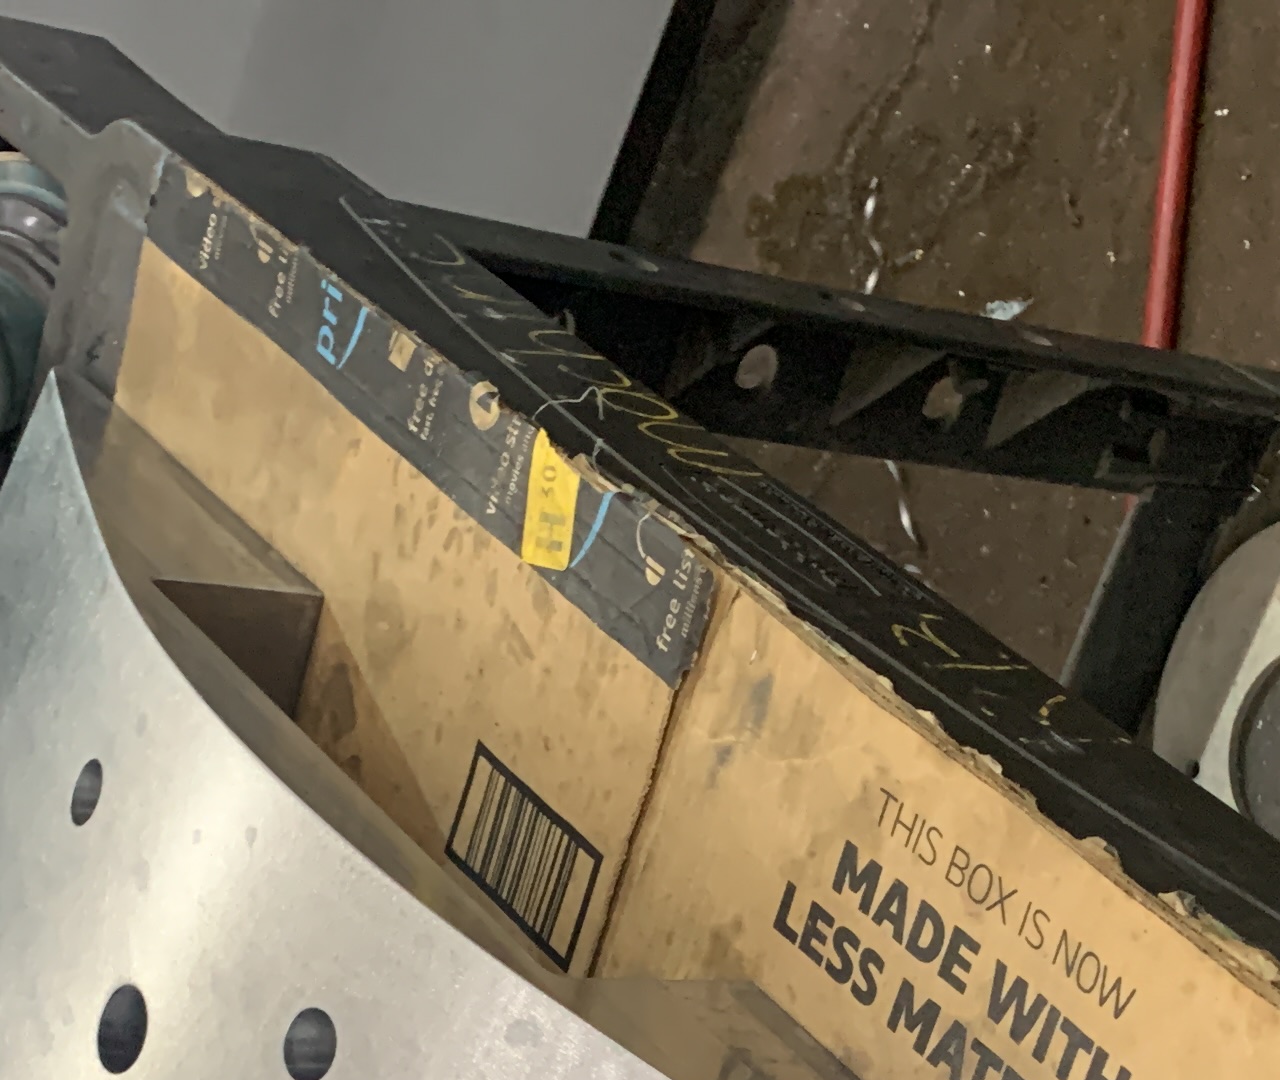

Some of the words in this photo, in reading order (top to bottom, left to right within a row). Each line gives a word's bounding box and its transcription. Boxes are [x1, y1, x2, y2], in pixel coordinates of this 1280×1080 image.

[316, 279, 343, 365] pri
[656, 598, 681, 652] free
[773, 881, 885, 1006] LESS
[832, 840, 981, 995] MADE
[877, 787, 943, 866] THIS
[945, 845, 1018, 925] BOX
[1018, 902, 1051, 951] IS
[1052, 929, 1136, 1020] NOW
